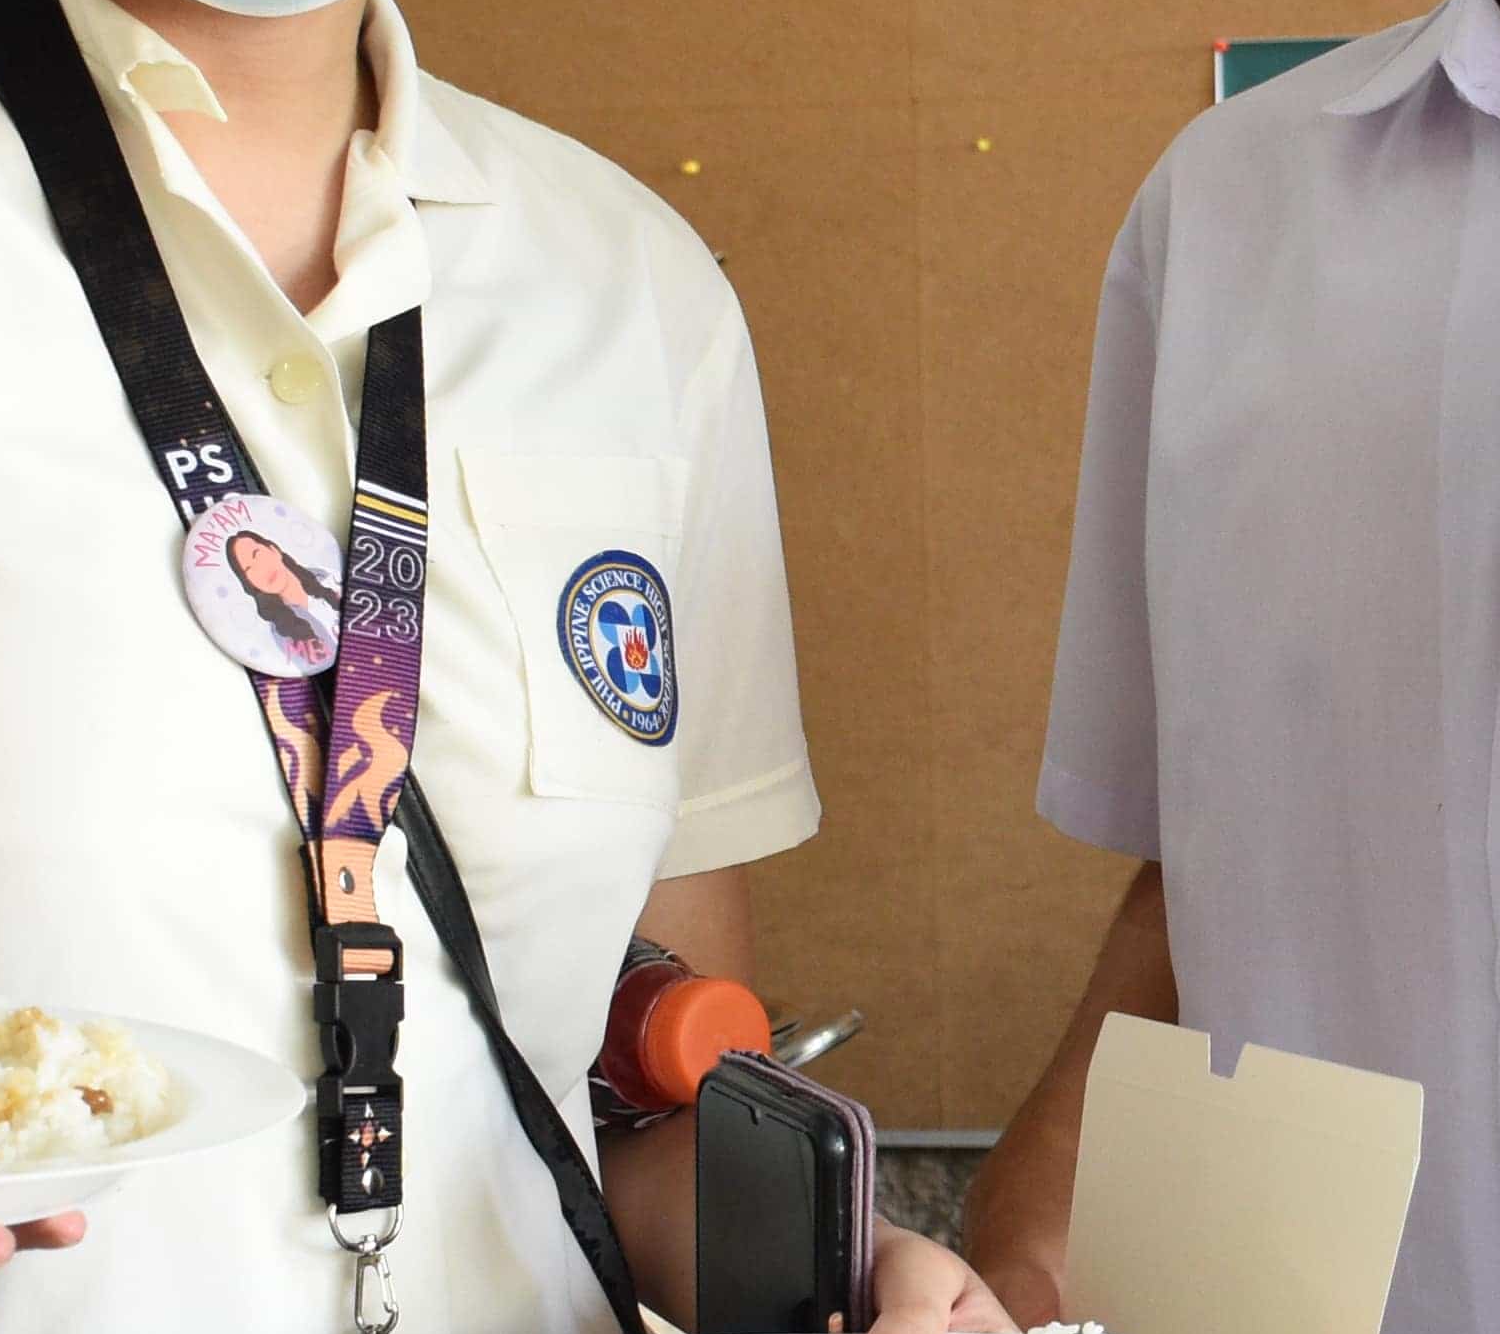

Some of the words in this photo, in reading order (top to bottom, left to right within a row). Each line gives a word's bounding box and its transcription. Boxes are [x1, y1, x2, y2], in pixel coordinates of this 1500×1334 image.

[165, 444, 233, 490] PS
[195, 499, 252, 568] MA'AM
[352, 535, 425, 591] 20
[582, 569, 643, 602] SCIENCE
[347, 589, 419, 644] 23
[643, 580, 670, 634] HIGH
[571, 598, 623, 717] PHILIPPINE
[631, 710, 660, 732] 1964
